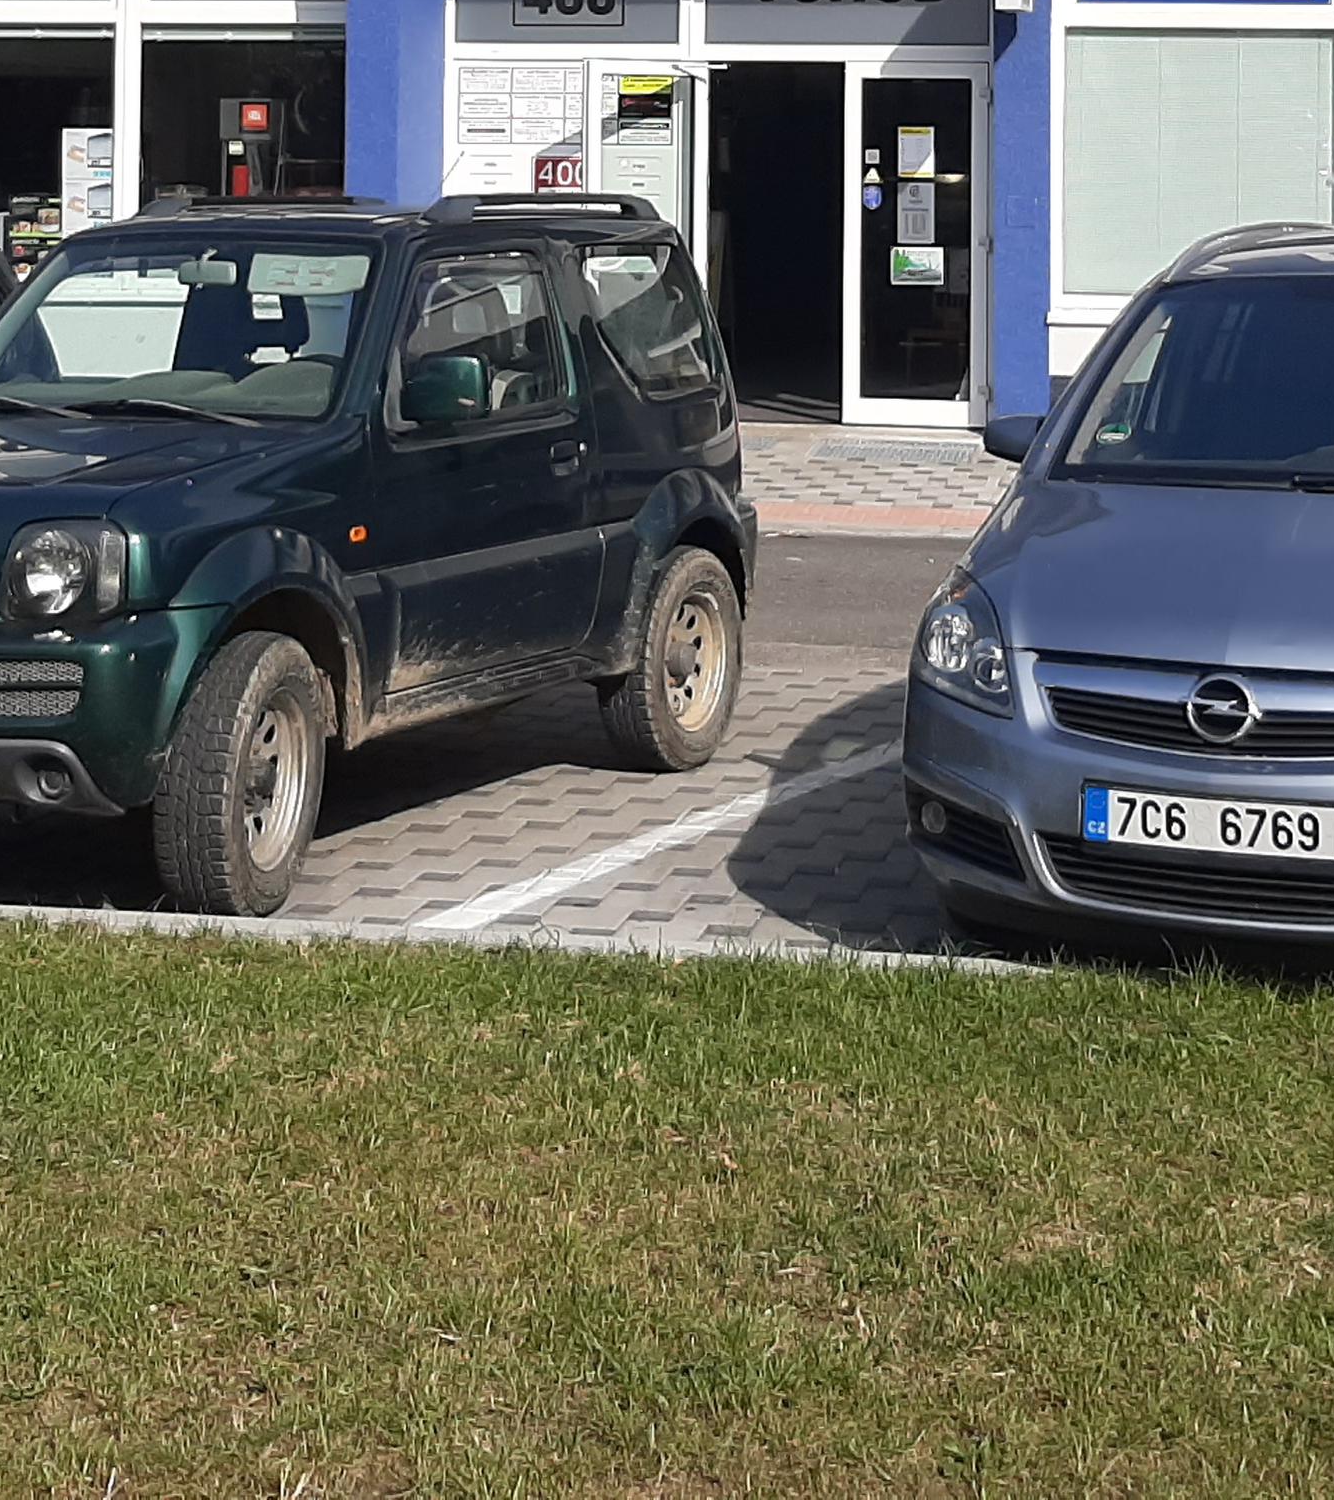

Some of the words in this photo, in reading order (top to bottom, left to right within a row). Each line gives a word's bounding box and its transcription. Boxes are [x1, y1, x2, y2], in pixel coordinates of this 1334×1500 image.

[1087, 820, 1106, 834] CZ
[1117, 796, 1187, 841] 7C6
[1219, 806, 1321, 851] 6769
